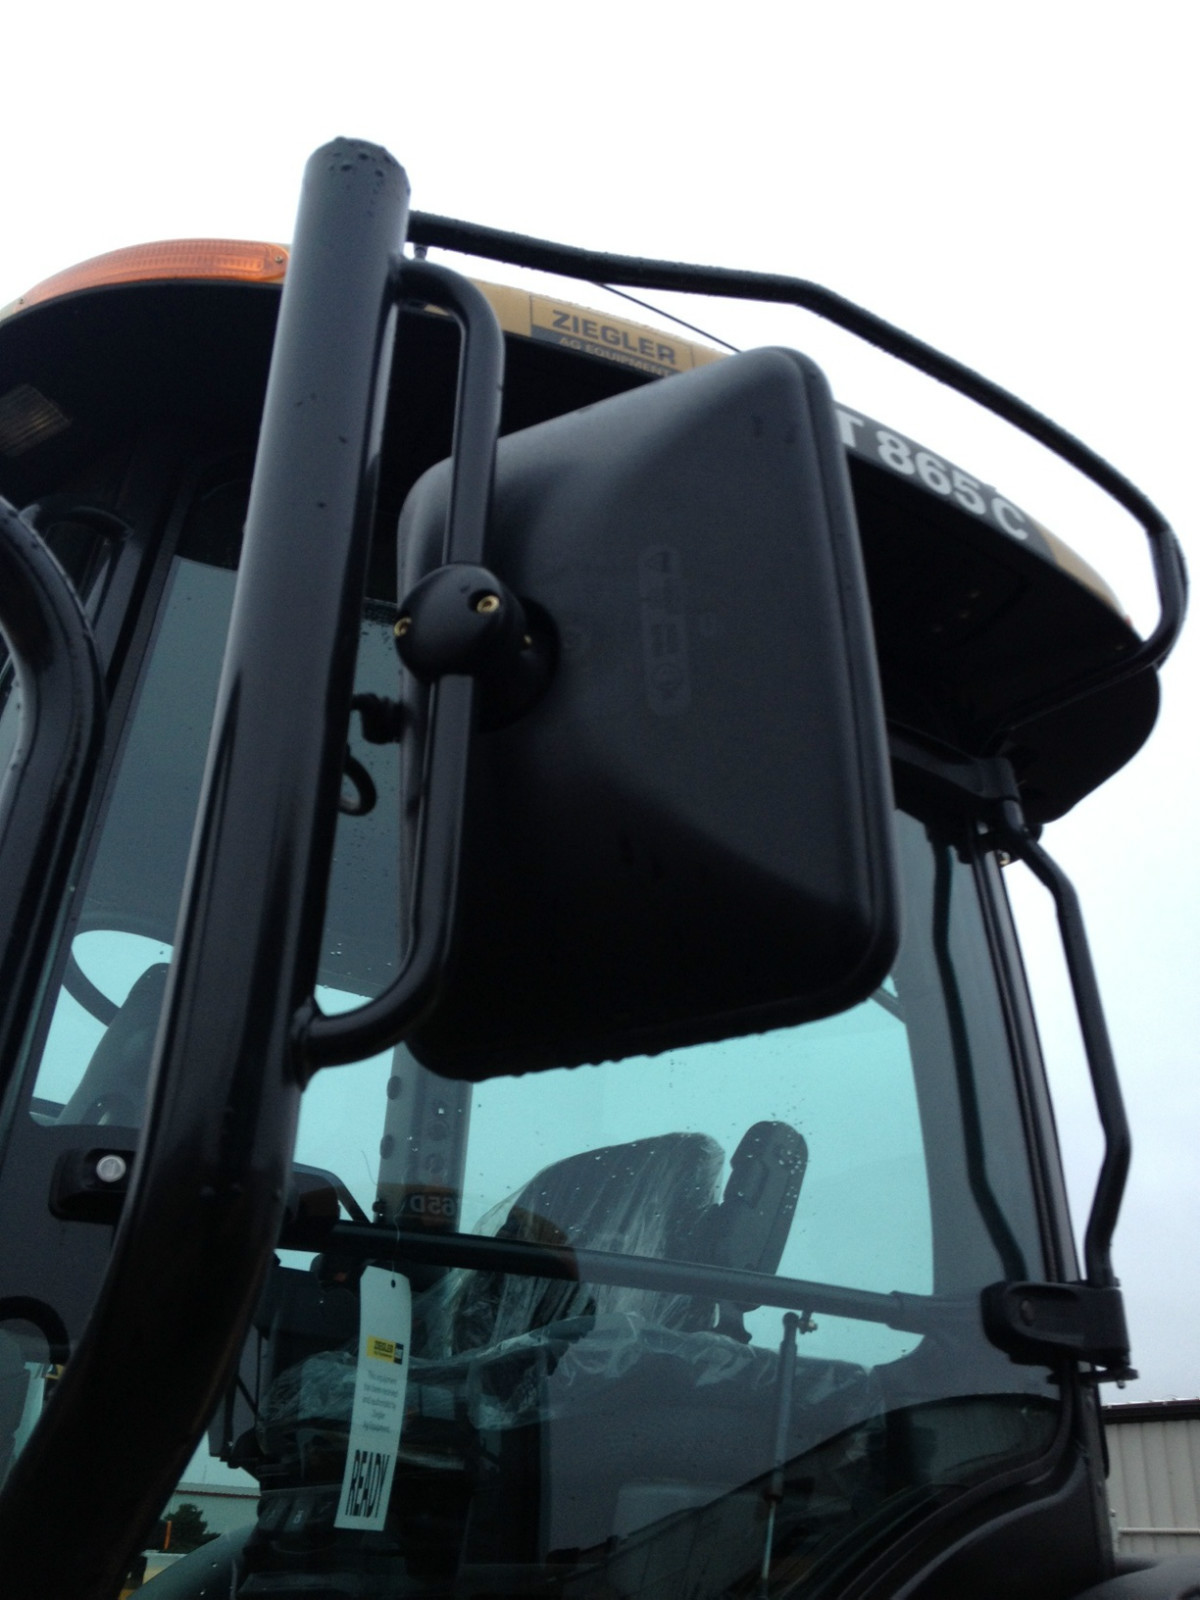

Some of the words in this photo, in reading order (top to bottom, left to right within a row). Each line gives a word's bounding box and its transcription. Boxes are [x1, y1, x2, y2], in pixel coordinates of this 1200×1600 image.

[552, 309, 676, 365] ZIEGLER
[559, 336, 582, 350] AG
[585, 343, 669, 378] EQUIPMENT
[345, 1449, 391, 1518] READY
